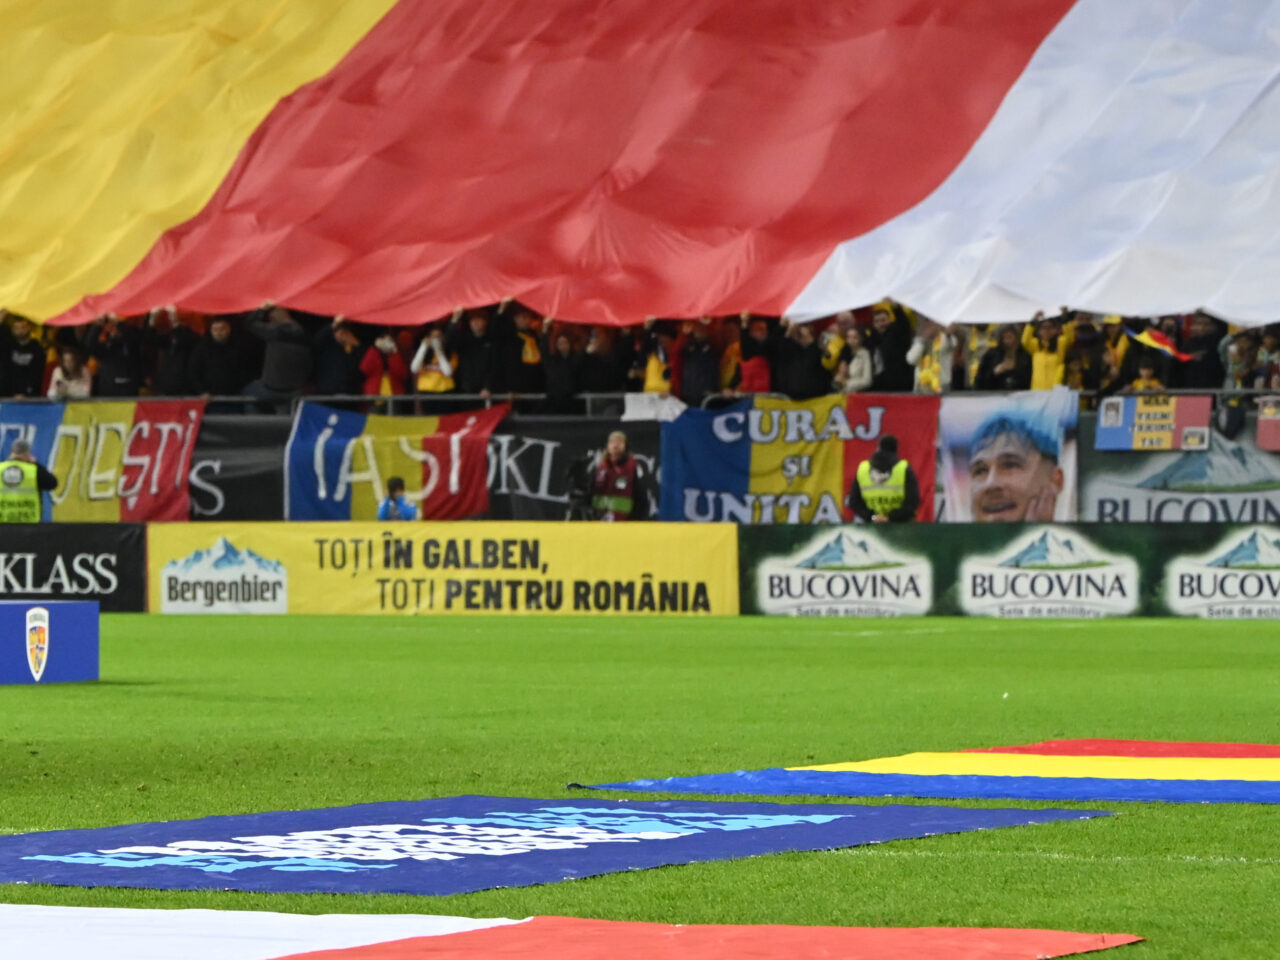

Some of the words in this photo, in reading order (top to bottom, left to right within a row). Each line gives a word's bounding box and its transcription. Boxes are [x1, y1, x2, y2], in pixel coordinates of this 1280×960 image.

[712, 405, 886, 443] CURAJ
[382, 531, 413, 570] ÎN
[423, 538, 548, 575] GALBEN,
[167, 575, 283, 607] Bergenbier
[444, 579, 564, 611] PENTRU
[573, 573, 712, 613] ROMÂNIA
[768, 573, 922, 599] BUCOVINA
[970, 573, 1127, 599] BUCOVINA
